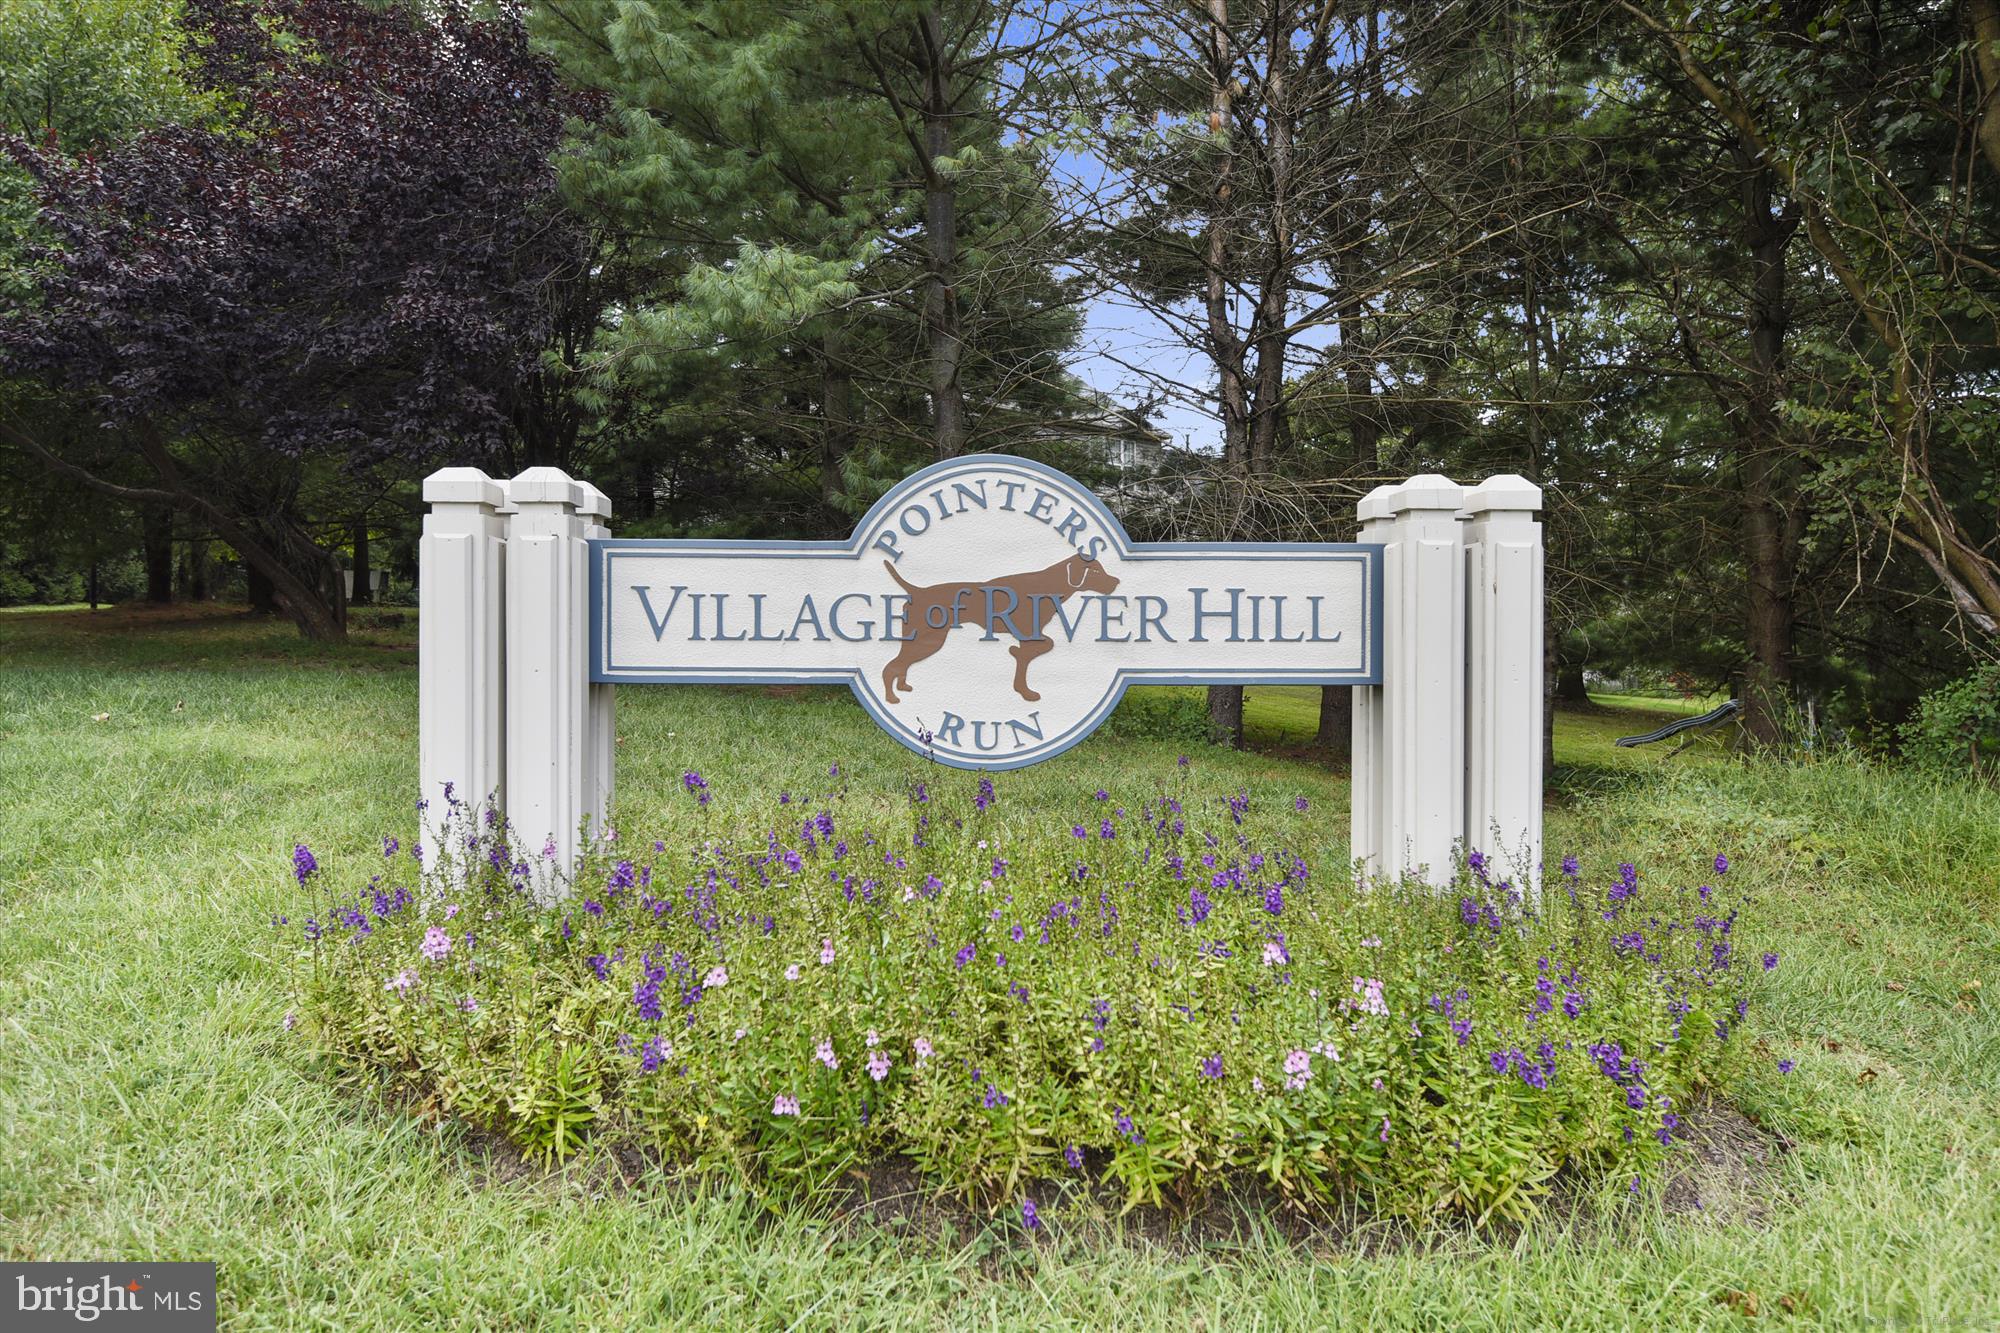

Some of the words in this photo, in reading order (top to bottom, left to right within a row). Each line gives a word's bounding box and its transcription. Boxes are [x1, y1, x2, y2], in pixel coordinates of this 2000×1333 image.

[872, 479, 1107, 563] POINTERS
[630, 585, 918, 642] VILLAGE
[925, 588, 971, 629] of
[979, 586, 1178, 642] RIVER
[1187, 587, 1342, 642] HILL
[934, 711, 1044, 751] RUN
